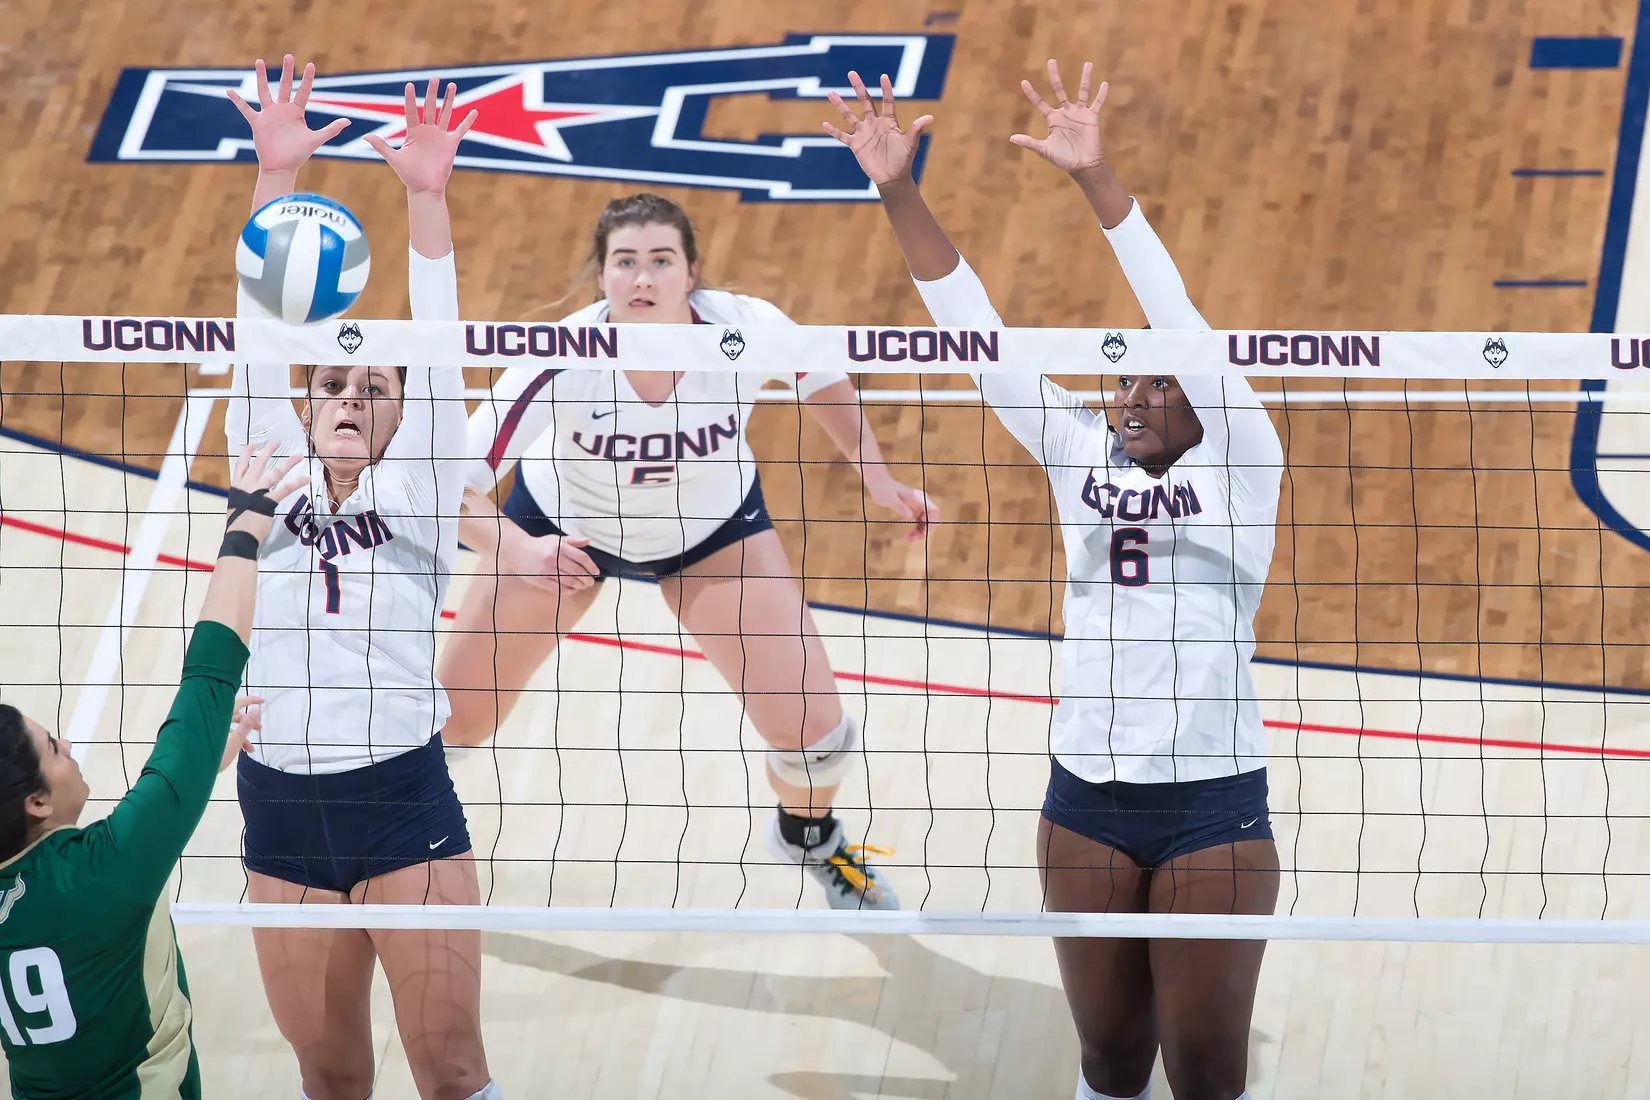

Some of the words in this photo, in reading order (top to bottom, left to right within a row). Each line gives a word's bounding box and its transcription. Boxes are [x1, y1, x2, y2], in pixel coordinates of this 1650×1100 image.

[82, 319, 236, 352] UCONN
[465, 324, 618, 359] UCONN
[847, 329, 999, 362] UCONN
[1228, 334, 1380, 367] UCONN
[572, 414, 738, 461] UCONN
[1109, 527, 1150, 588] 6
[318, 558, 341, 615] 1
